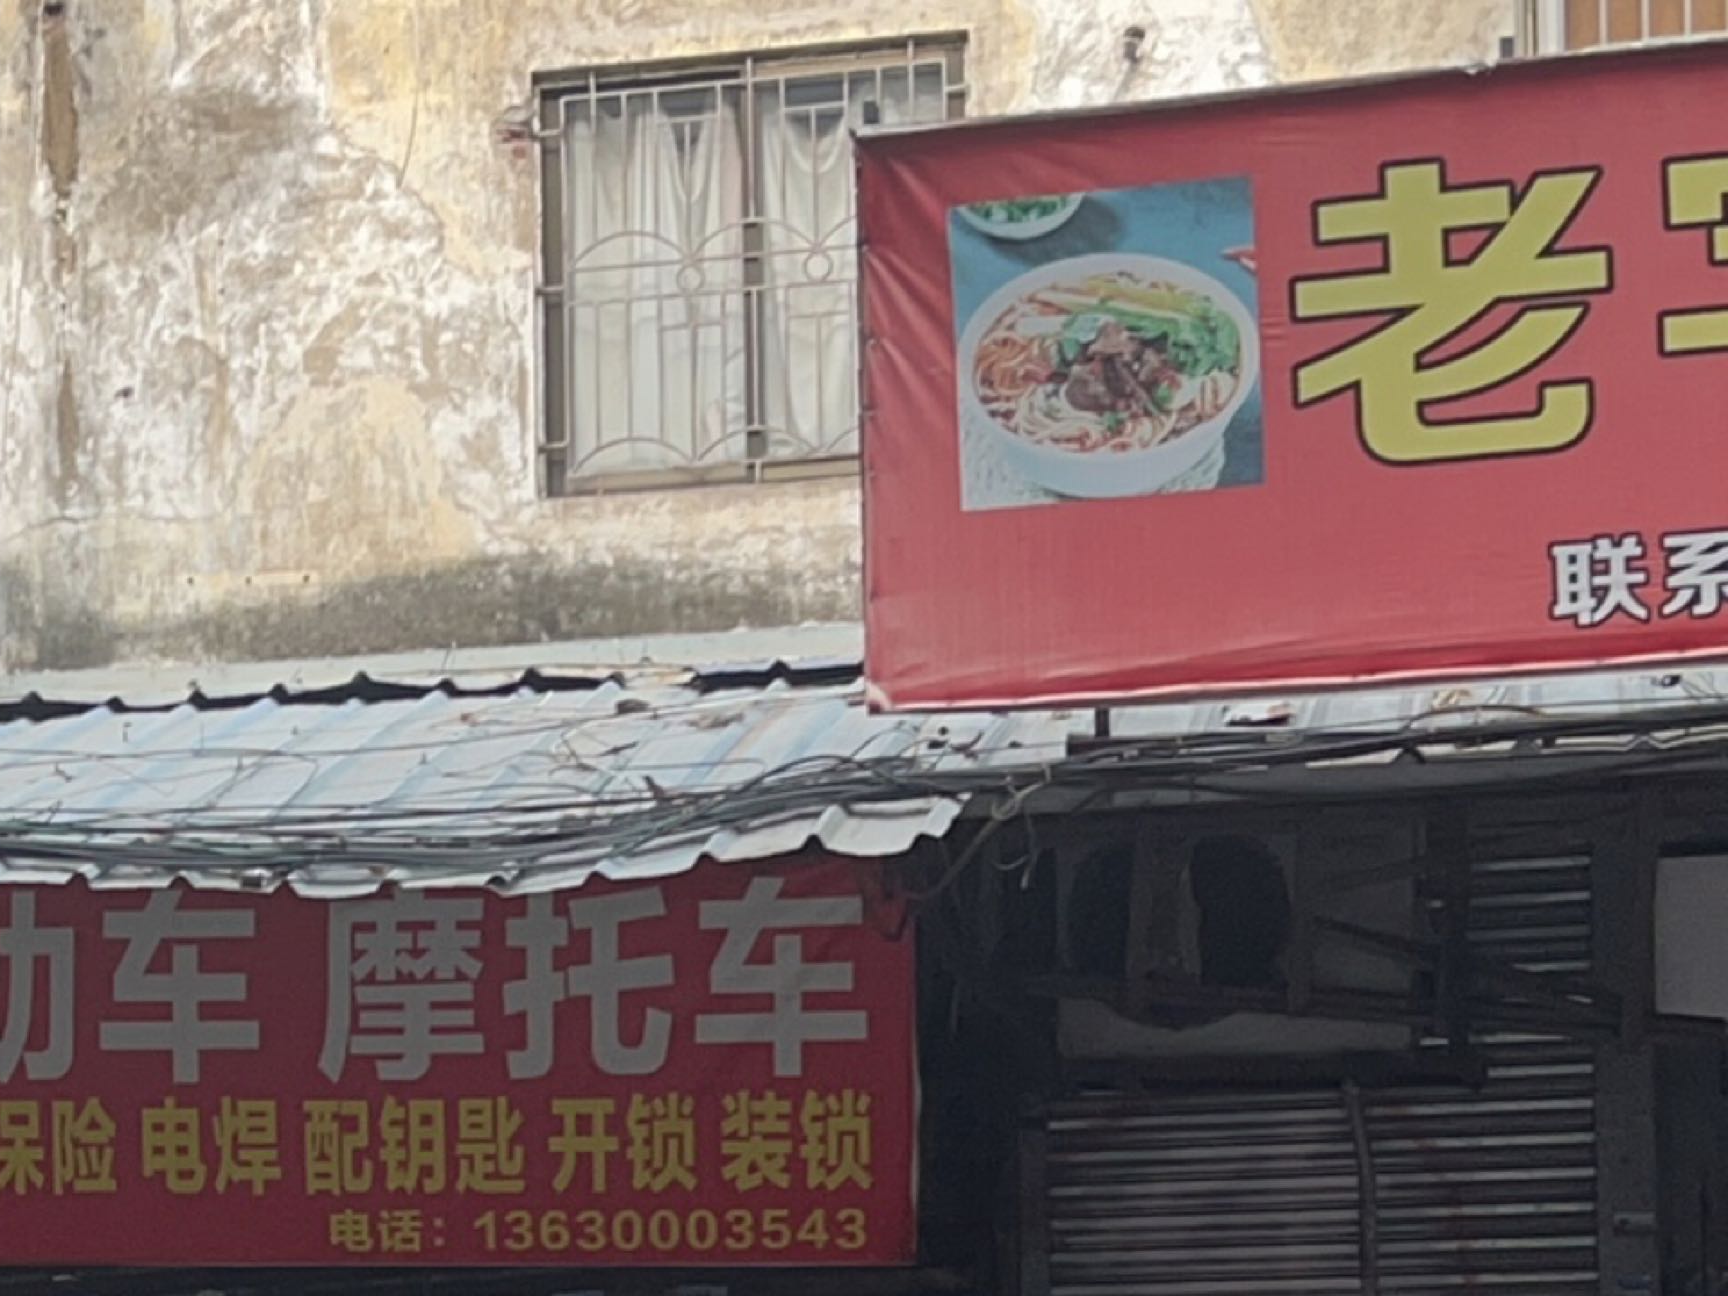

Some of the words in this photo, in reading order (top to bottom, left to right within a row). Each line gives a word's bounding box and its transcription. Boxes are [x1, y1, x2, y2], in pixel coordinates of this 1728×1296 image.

[1292, 154, 1728, 466] 老
[1548, 527, 1728, 628] 联系
[317, 876, 869, 1084] 摩托车
[140, 1095, 282, 1197] 电焊
[302, 1095, 525, 1196] 配钥匙
[548, 1092, 698, 1194] 开锁
[718, 1089, 875, 1193] 装锁
